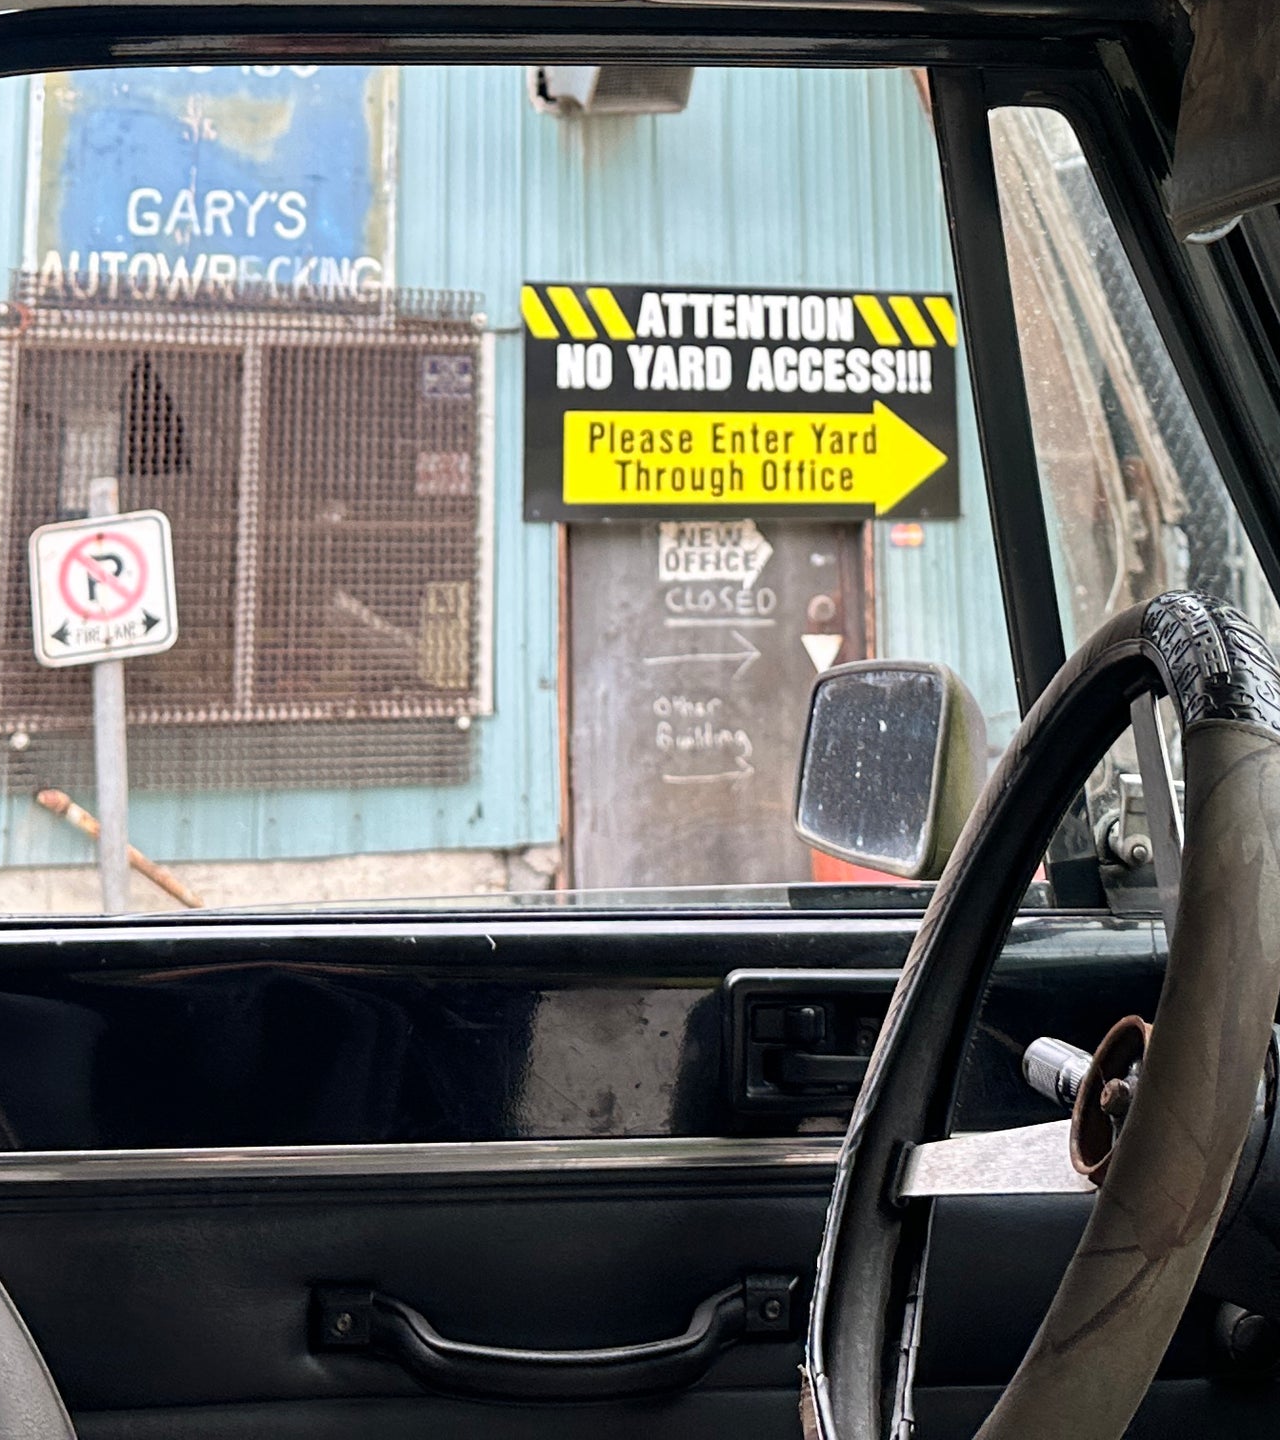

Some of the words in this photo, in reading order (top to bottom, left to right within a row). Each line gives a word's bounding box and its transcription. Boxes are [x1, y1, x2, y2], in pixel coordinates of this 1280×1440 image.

[126, 187, 308, 240] GARY'S
[635, 291, 855, 342] ATTENTION
[555, 343, 613, 390] NO
[626, 344, 732, 392] YARD
[745, 347, 933, 394] ACCESS!!!
[588, 421, 693, 454] Please
[712, 423, 794, 454] Enter
[810, 423, 877, 455] Yard
[615, 459, 744, 497] Through
[762, 460, 854, 491] Office
[676, 526, 744, 548] NEW
[664, 549, 758, 573] OFFICE
[664, 586, 778, 616] CLOSED
